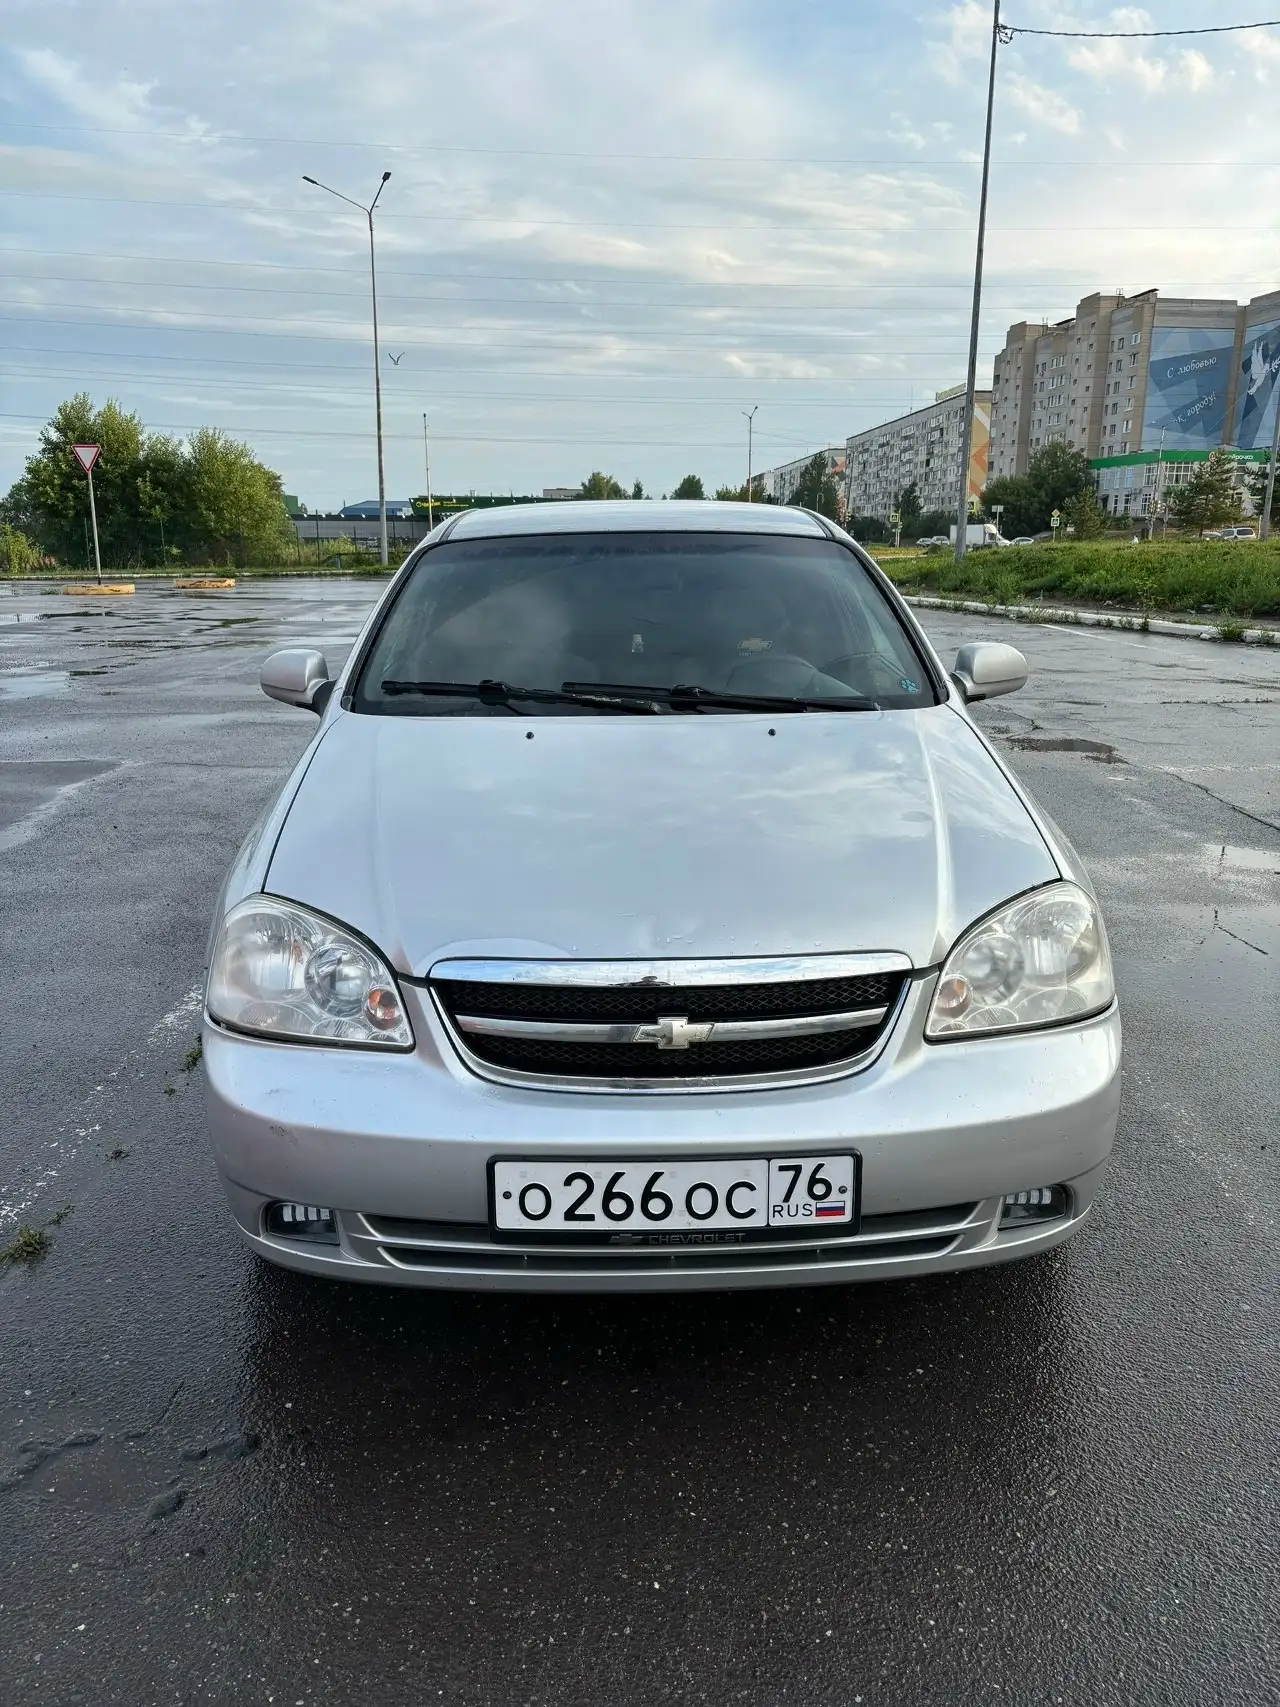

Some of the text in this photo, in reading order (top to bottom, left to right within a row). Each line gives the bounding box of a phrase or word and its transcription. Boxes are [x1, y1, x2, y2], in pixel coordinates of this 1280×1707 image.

[1167, 357, 1217, 378] С любовью
[1187, 391, 1217, 417] городу!
[777, 1162, 833, 1204] 76
[772, 1203, 813, 1218] RUS
[648, 1232, 746, 1245] CHEVROLET
